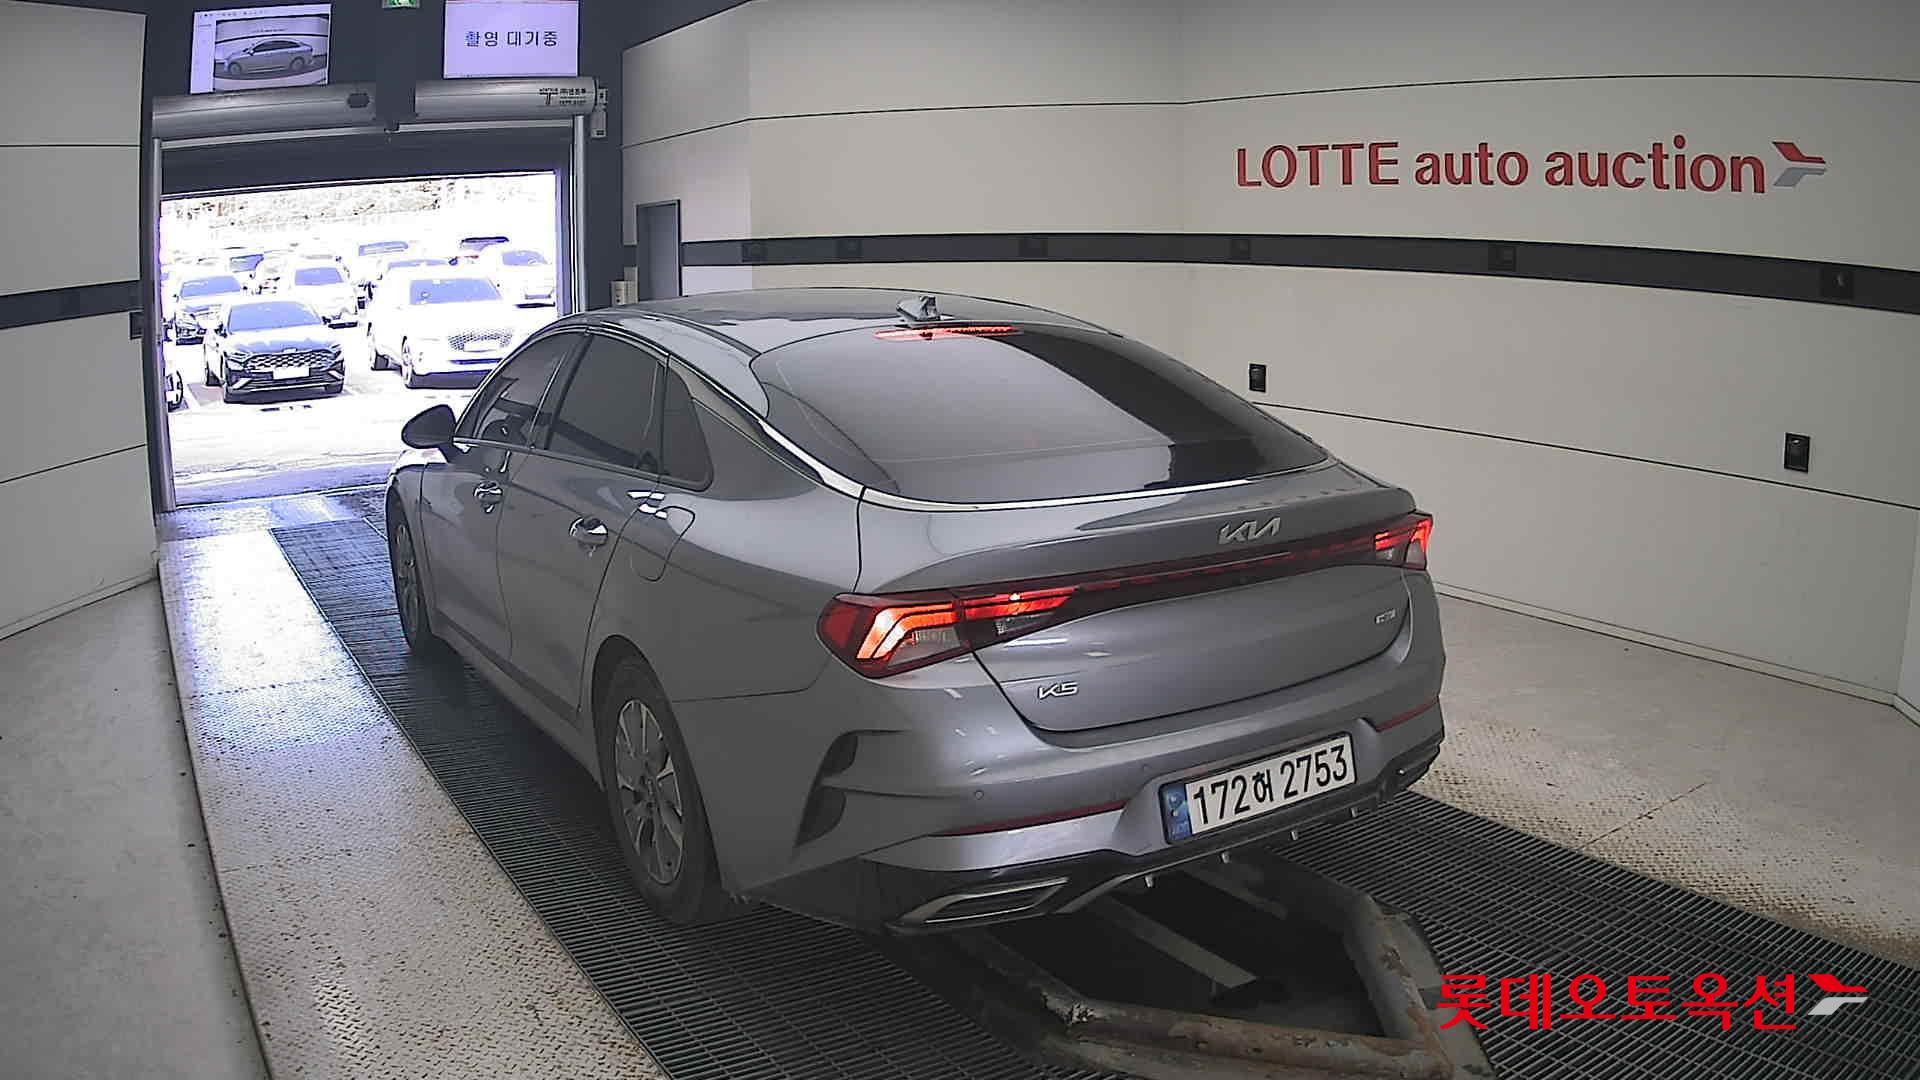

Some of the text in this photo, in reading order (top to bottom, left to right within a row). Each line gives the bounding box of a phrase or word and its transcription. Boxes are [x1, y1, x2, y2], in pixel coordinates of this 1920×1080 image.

[507, 31, 558, 48] 대기중
[1236, 135, 1766, 194] LOTTE auto auction
[1036, 681, 1079, 700] K5
[1192, 744, 1348, 825] 172허 2753
